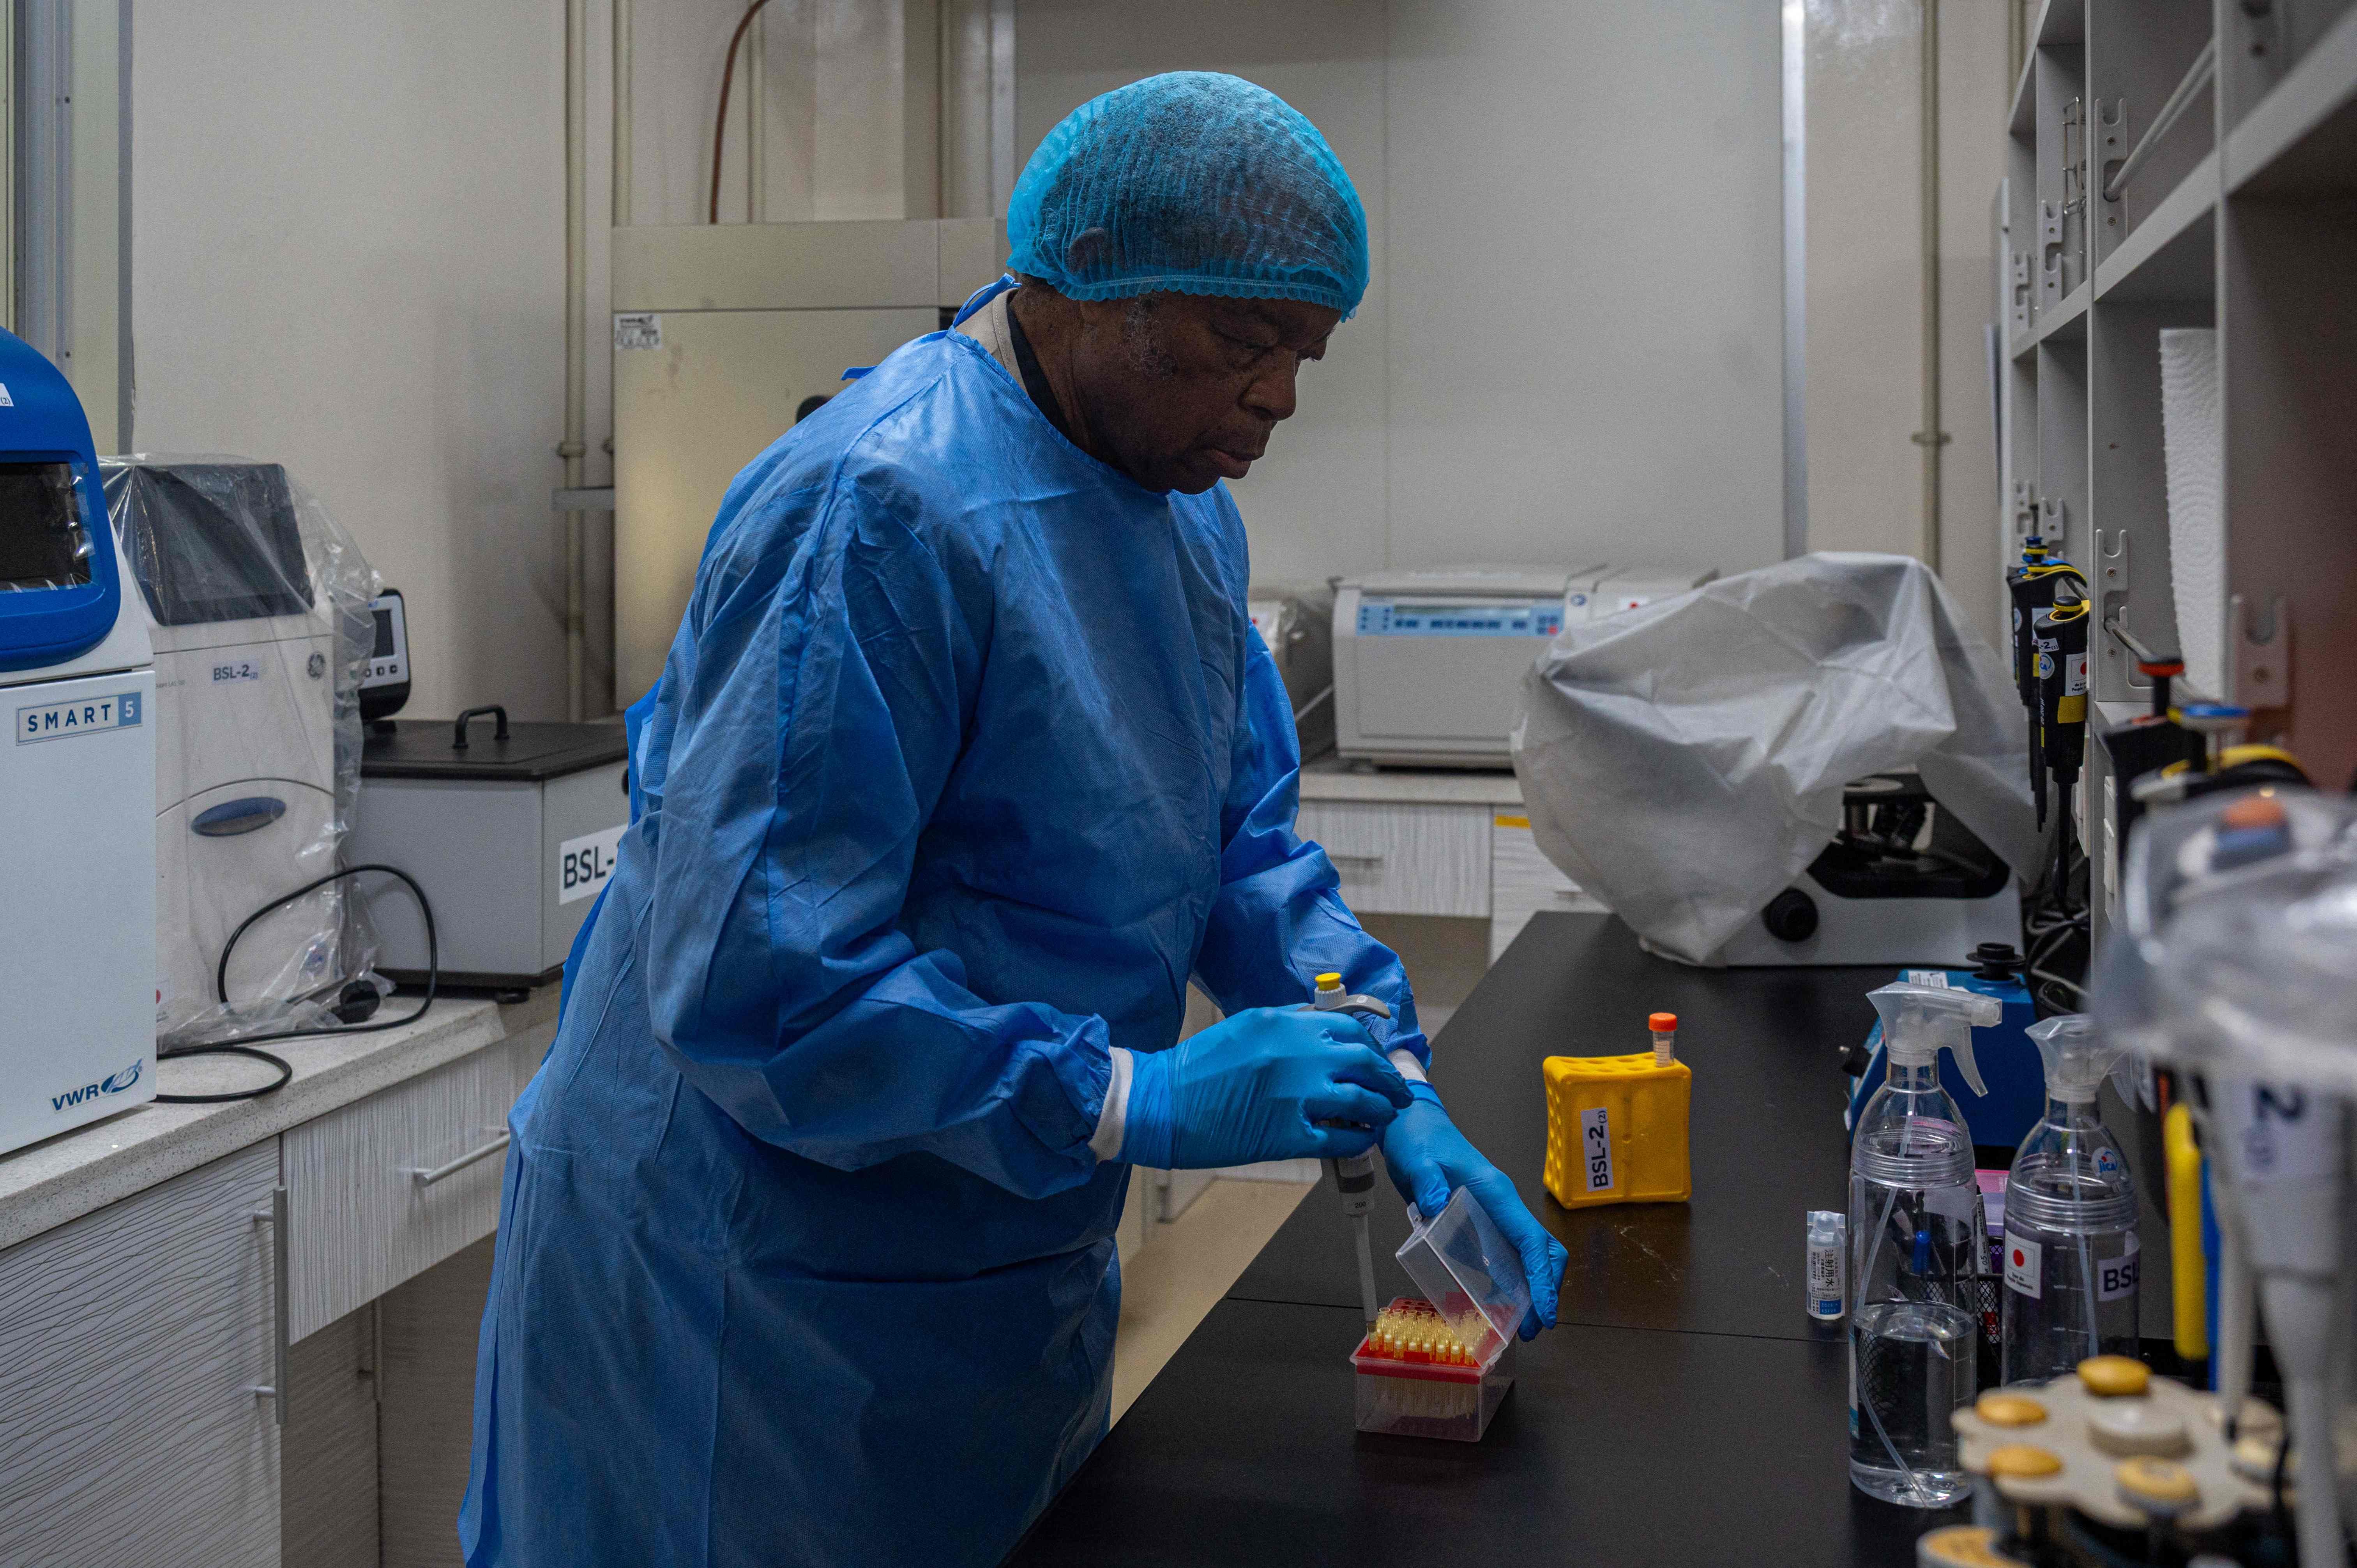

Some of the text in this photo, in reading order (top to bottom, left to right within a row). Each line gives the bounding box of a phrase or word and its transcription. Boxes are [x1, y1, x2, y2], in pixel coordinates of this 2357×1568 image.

[28, 701, 134, 732] SMART 5
[564, 840, 620, 889] BSL-
[52, 1084, 99, 1111] VWR
[1825, 1249, 1834, 1287] 注射用水
